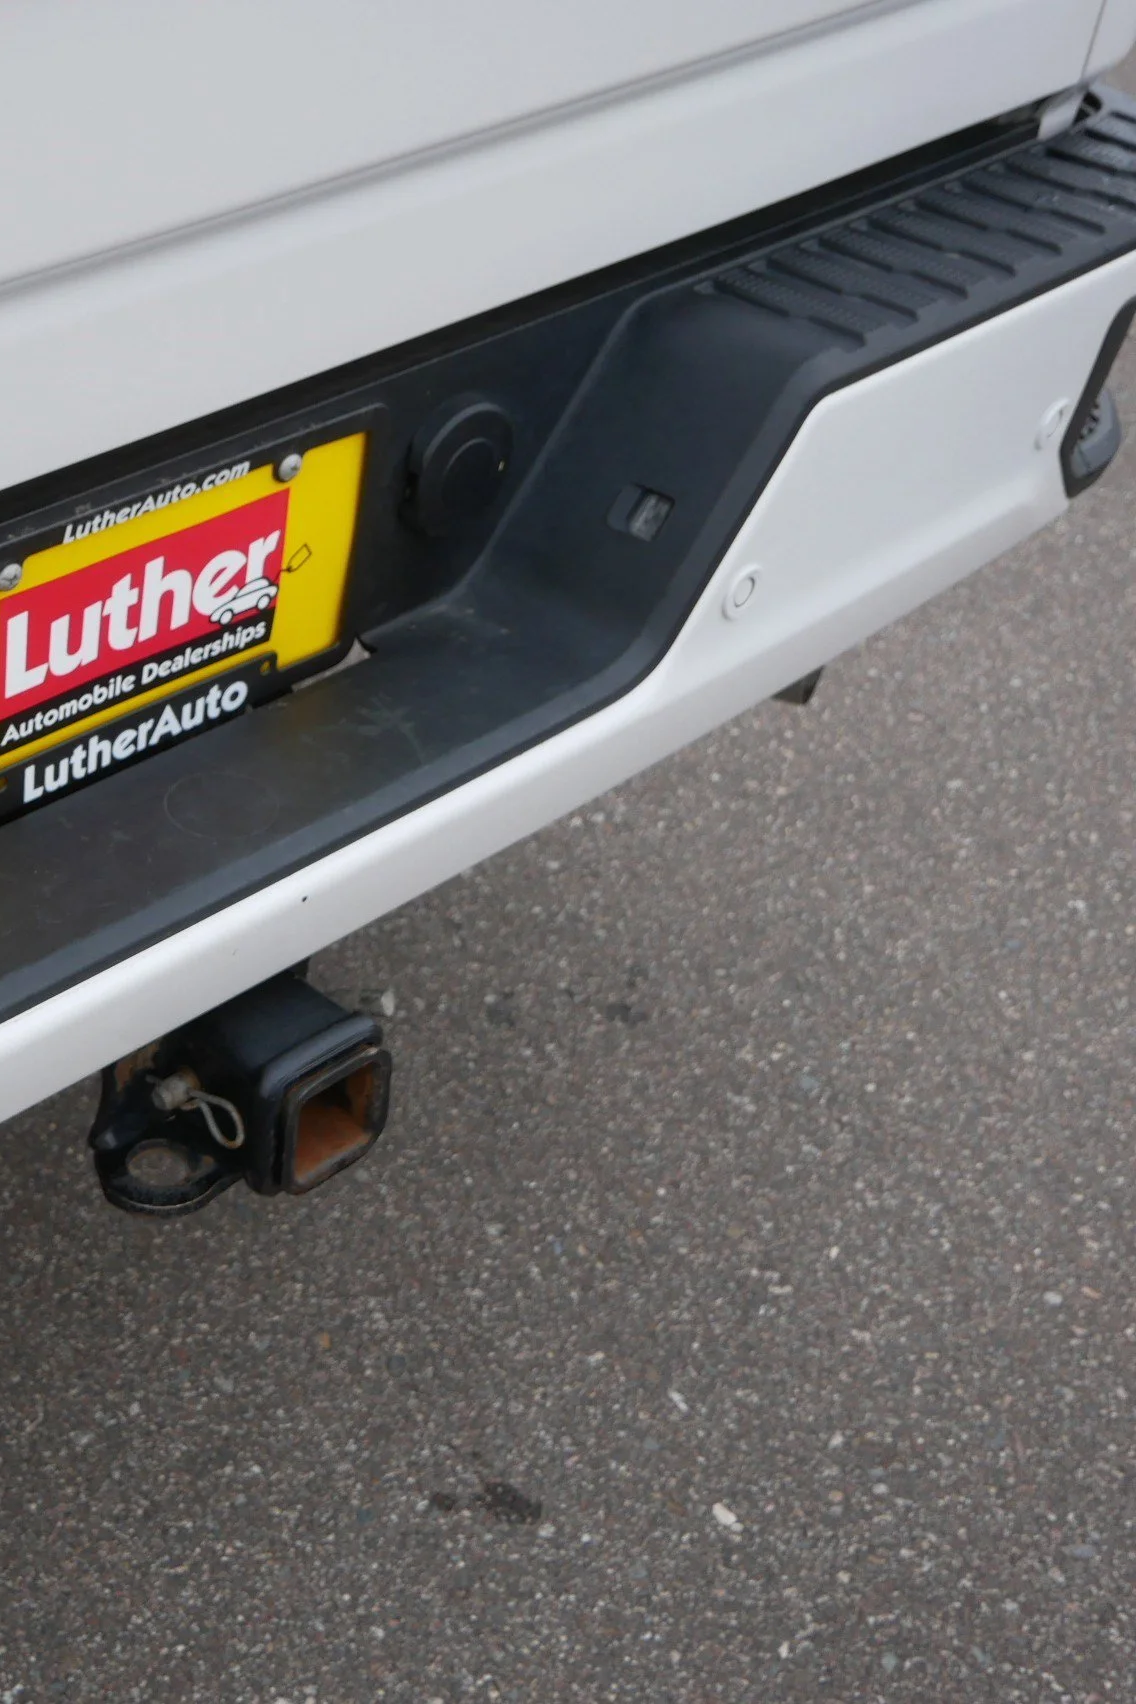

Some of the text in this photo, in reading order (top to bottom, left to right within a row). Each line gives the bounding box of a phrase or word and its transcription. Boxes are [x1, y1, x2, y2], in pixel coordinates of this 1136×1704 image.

[63, 461, 250, 544] LutherAuto.com
[4, 529, 282, 699] Luther
[0, 622, 266, 747] Automobile Dealerships
[23, 680, 249, 804] LutherAuto
